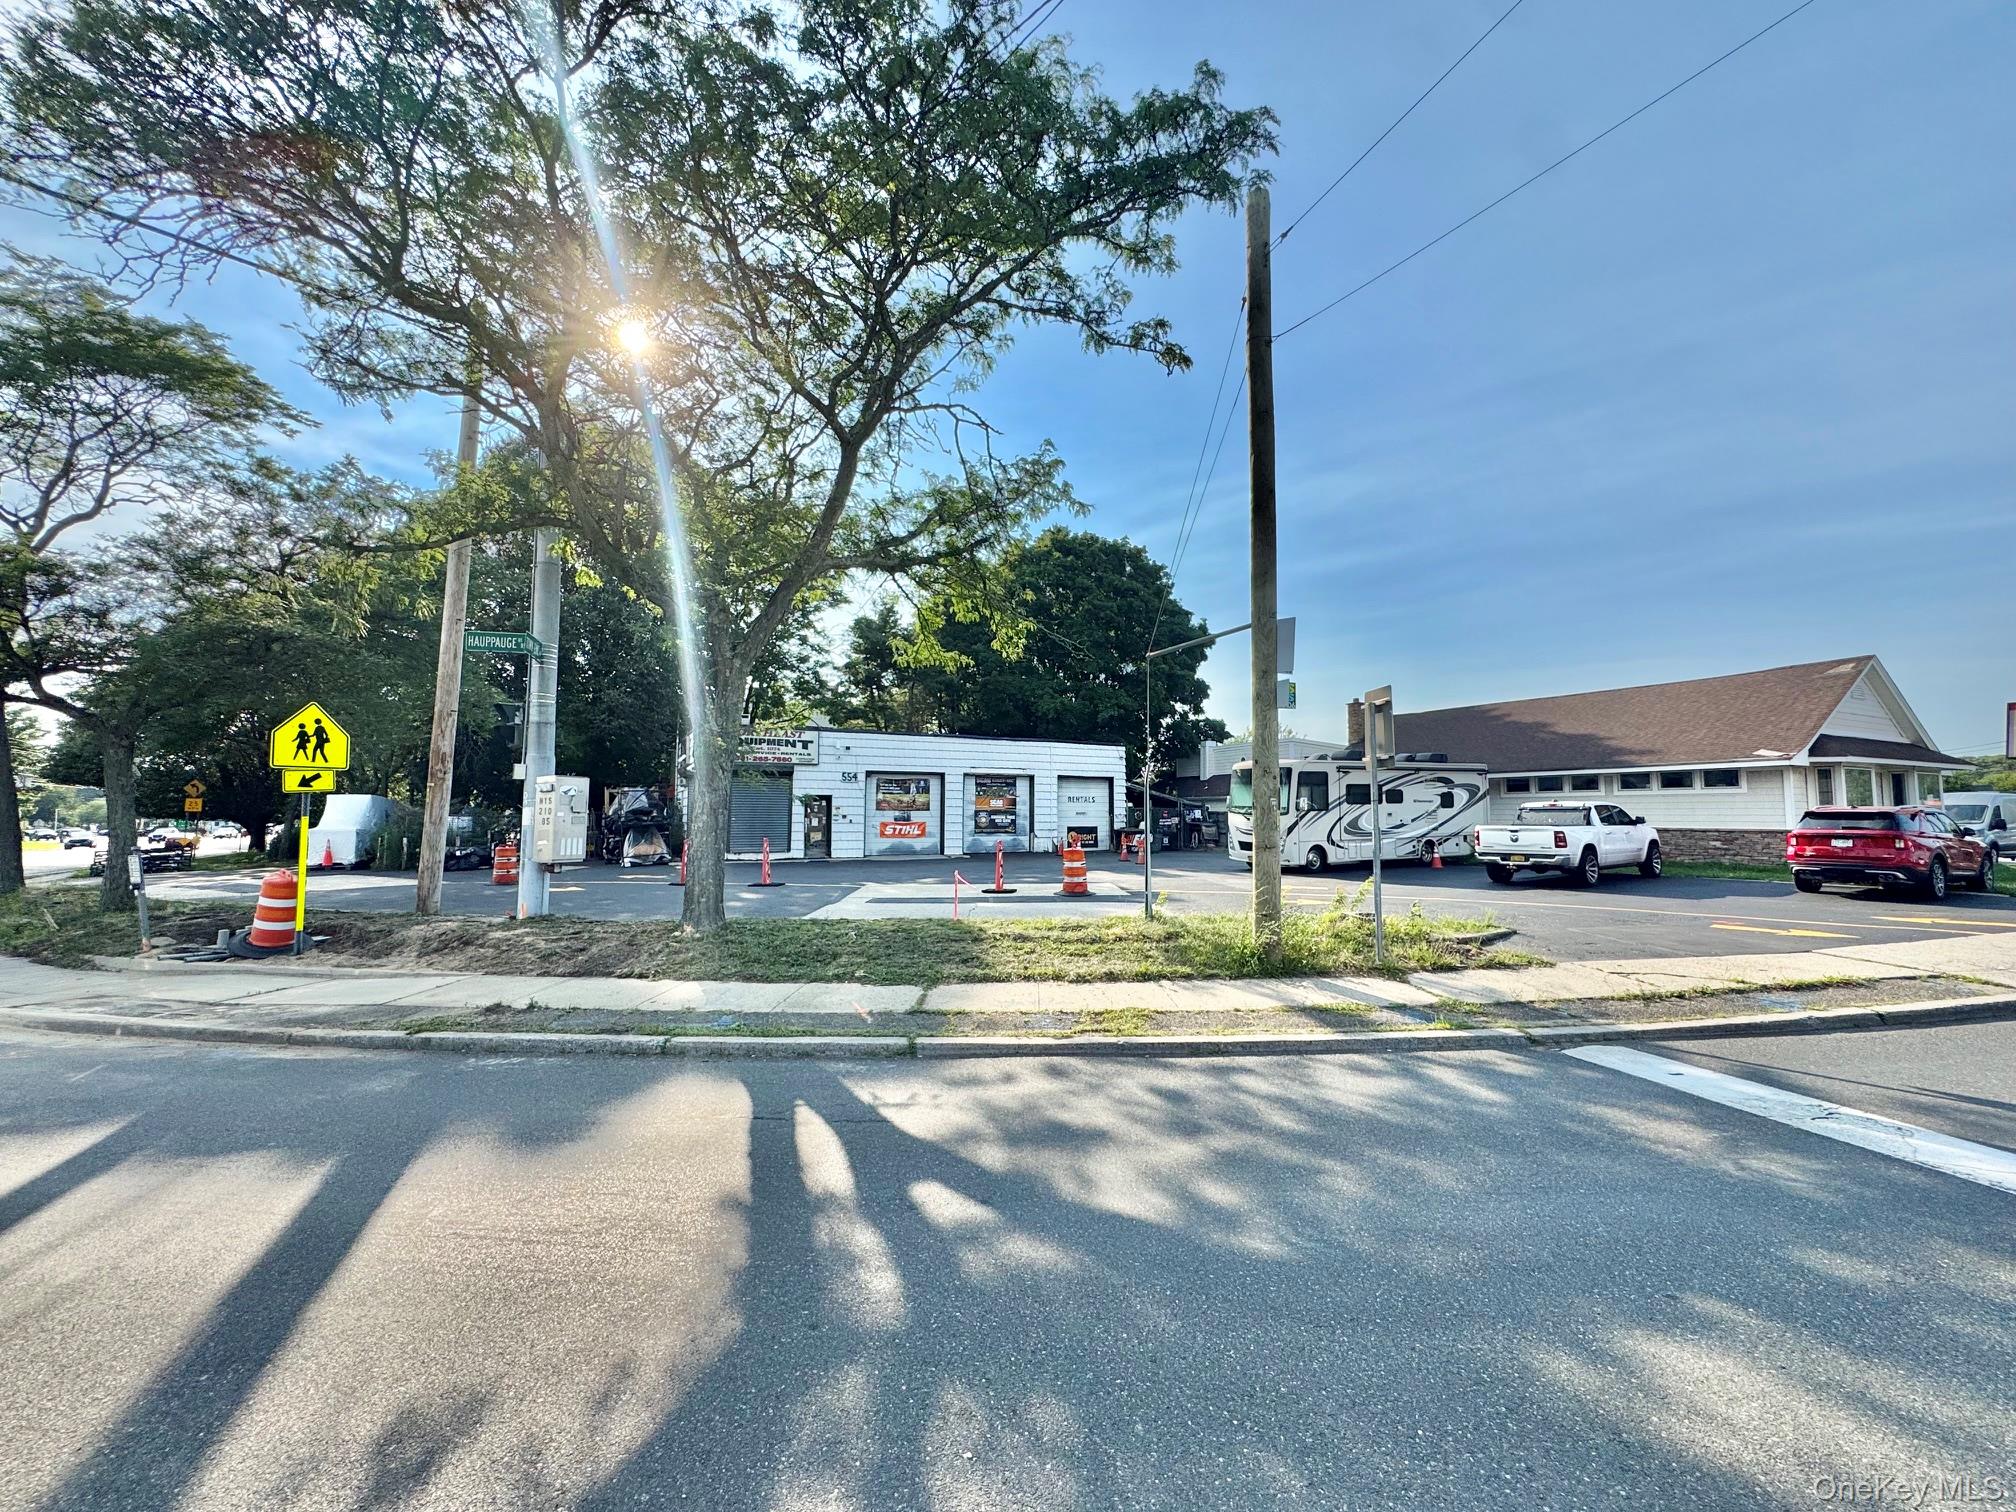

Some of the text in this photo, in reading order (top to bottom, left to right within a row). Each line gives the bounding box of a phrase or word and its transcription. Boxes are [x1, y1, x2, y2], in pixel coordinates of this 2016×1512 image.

[468, 635, 517, 649] HAUPPAUGE
[738, 736, 814, 750] QUIPMENT
[841, 771, 858, 782] 554
[1067, 796, 1096, 804] RENTALS
[884, 825, 922, 835] STIHL
